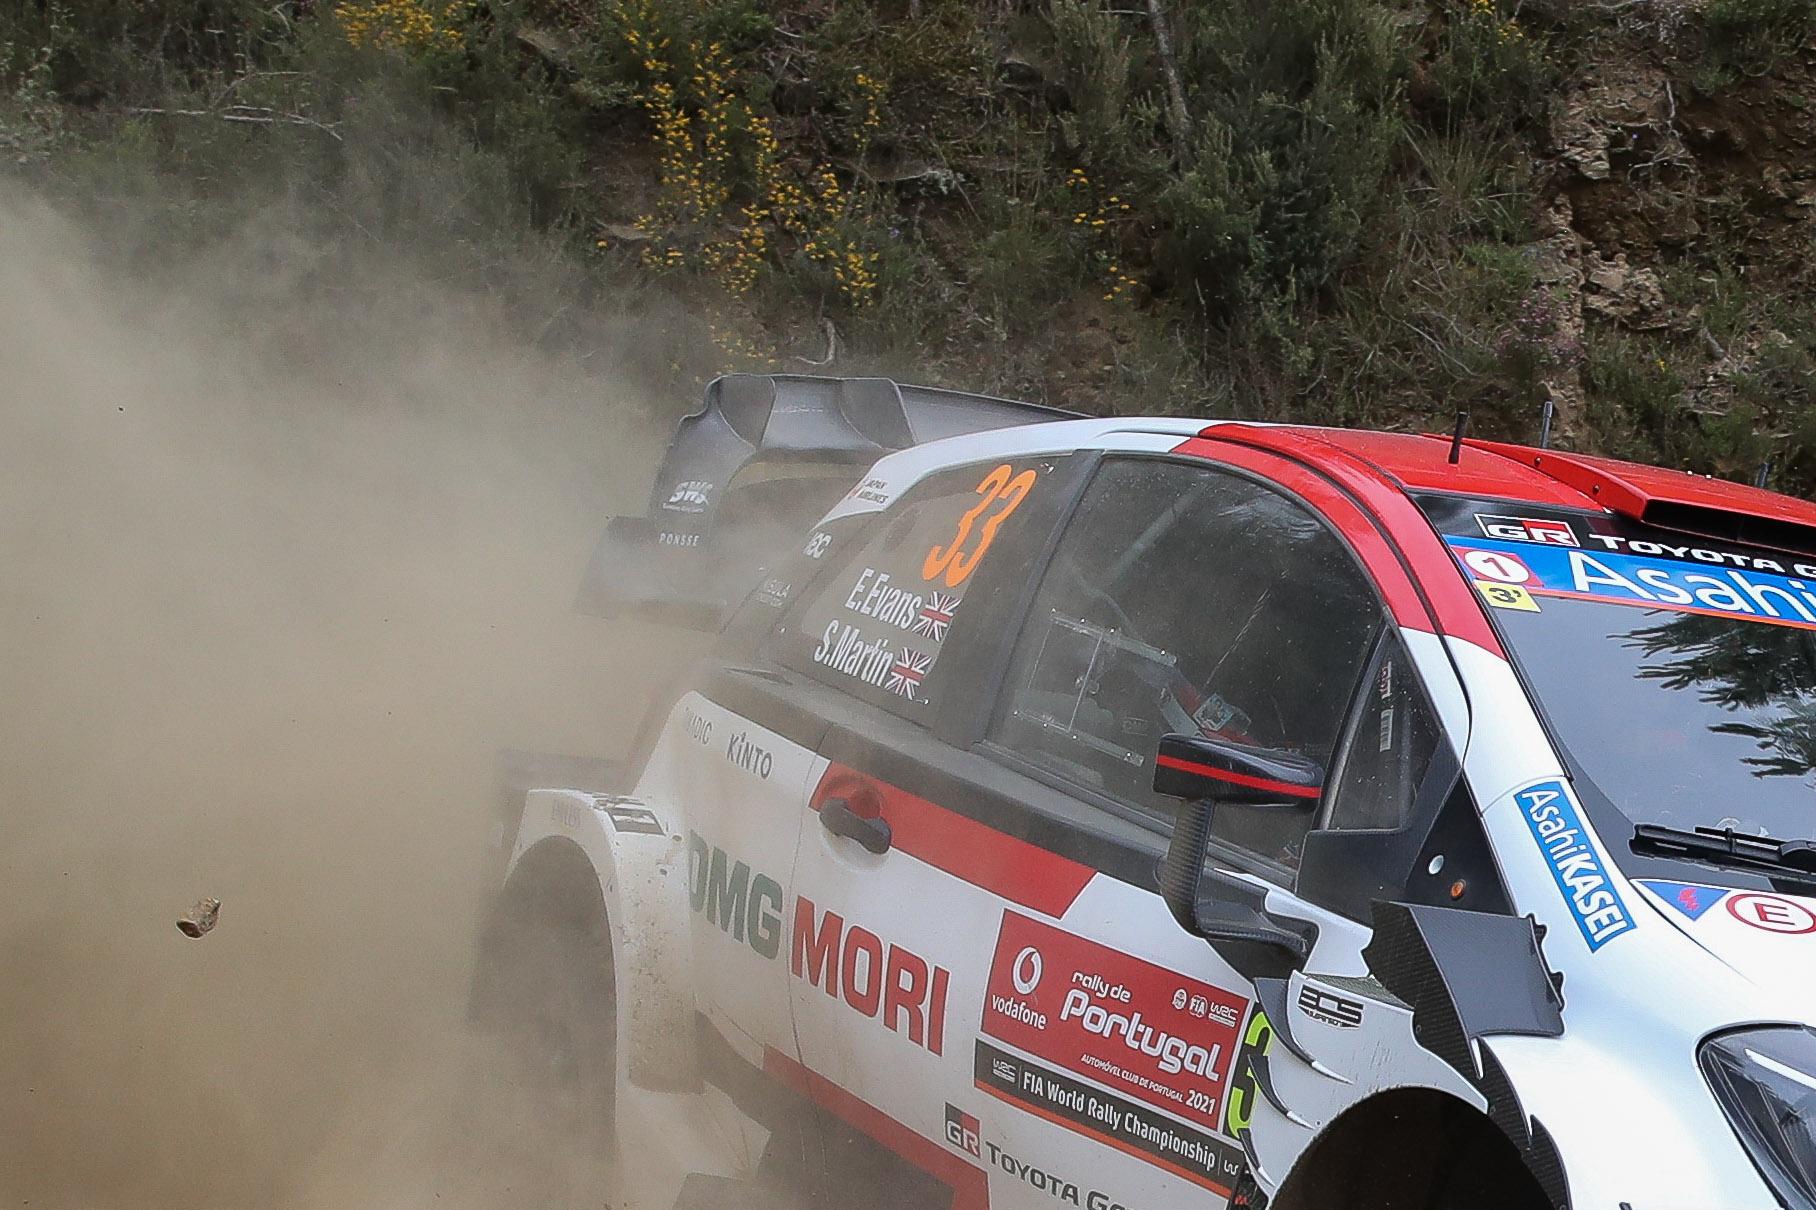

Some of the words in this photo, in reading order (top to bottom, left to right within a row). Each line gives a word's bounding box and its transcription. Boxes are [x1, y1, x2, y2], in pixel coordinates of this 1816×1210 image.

[659, 532, 700, 547] PONSSE
[922, 463, 1038, 588] 33
[1486, 524, 1573, 545] GR
[1589, 533, 1788, 575] TOYOTA
[845, 568, 922, 630] E.Evans
[1482, 557, 1511, 577] 1
[813, 620, 895, 688] S.Martin
[688, 829, 783, 960] DMG
[1521, 788, 1629, 942] AsahiKASEI
[1753, 902, 1796, 926] E
[791, 895, 951, 1058] MORI
[1071, 971, 1111, 998] rally
[1111, 983, 1133, 1003] de
[992, 993, 1048, 1030] vodafone
[1059, 988, 1221, 1082] Portugal
[1023, 1071, 1044, 1097] FIA
[1047, 1080, 1085, 1113] World
[1087, 1097, 1122, 1130] Rally
[1124, 1112, 1216, 1171] Championship
[1148, 1080, 1184, 1103] PORTUGAL
[1185, 1089, 1217, 1115] 2021
[945, 1120, 981, 1158] GR
[985, 1140, 1080, 1207] TOYOTA
